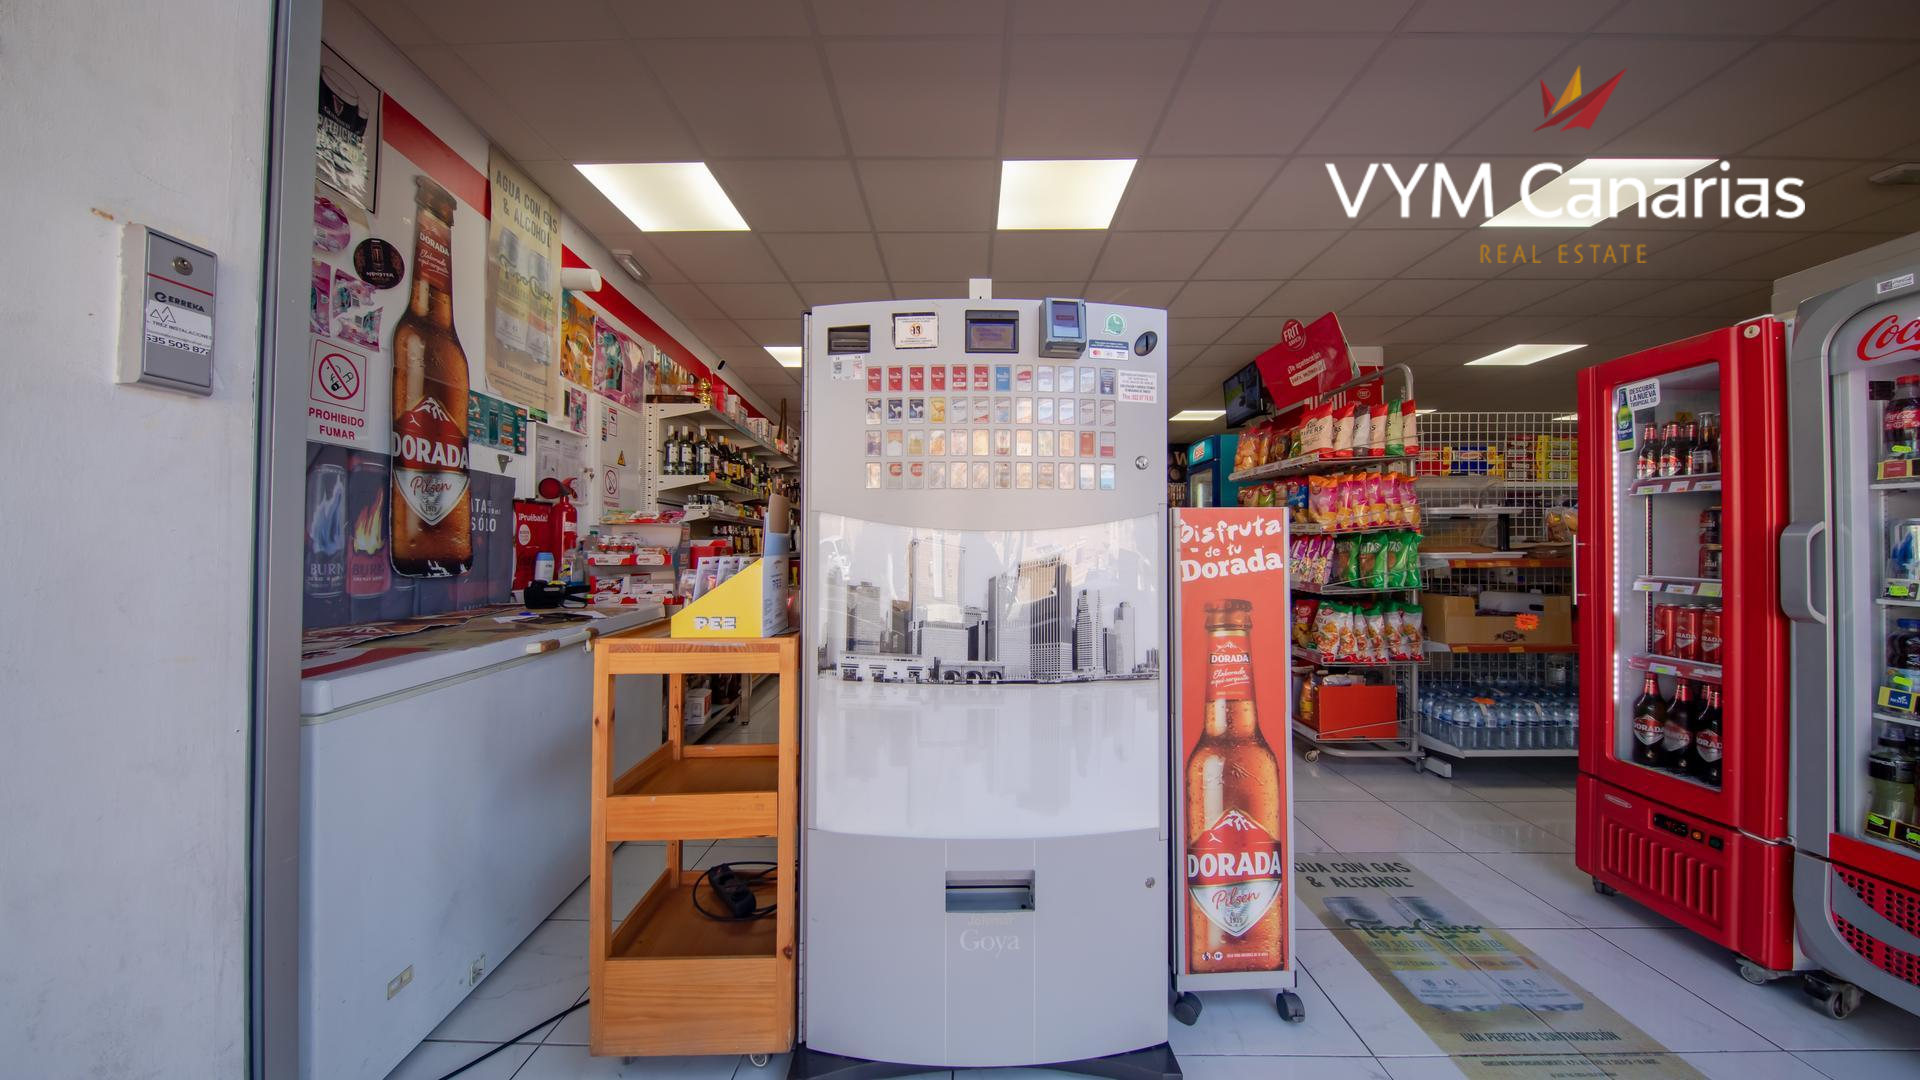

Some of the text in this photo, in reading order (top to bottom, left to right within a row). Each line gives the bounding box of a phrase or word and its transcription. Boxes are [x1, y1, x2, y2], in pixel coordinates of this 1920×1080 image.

[496, 170, 558, 234] AGUA CON GAS
[513, 208, 551, 248] ALCOHOL
[419, 231, 450, 257] DORADA
[168, 295, 205, 312] ERREKA
[1283, 323, 1299, 342] FRIT
[168, 340, 190, 350] 505
[1629, 382, 1656, 395] DESCUBRE
[1636, 389, 1657, 401] NUEVA
[308, 407, 365, 428] PROHIBIDO
[319, 424, 355, 440] FUMAR
[393, 432, 470, 469] DORADA
[410, 475, 453, 497] Pilsen
[1180, 514, 1282, 544] Disfruta
[1204, 543, 1242, 558] de tu
[1180, 547, 1284, 583] Dorada
[694, 616, 737, 630] PEZ
[1211, 654, 1249, 663] DORADA
[1187, 851, 1282, 878] DORADA
[1295, 862, 1412, 873] GUA CON GAS
[1305, 876, 1325, 888] &
[1212, 887, 1260, 911] Pilsen
[960, 929, 1021, 959] Goya
[1460, 1028, 1622, 1042] UNA PERFECTA CONTRADICCIÓN
